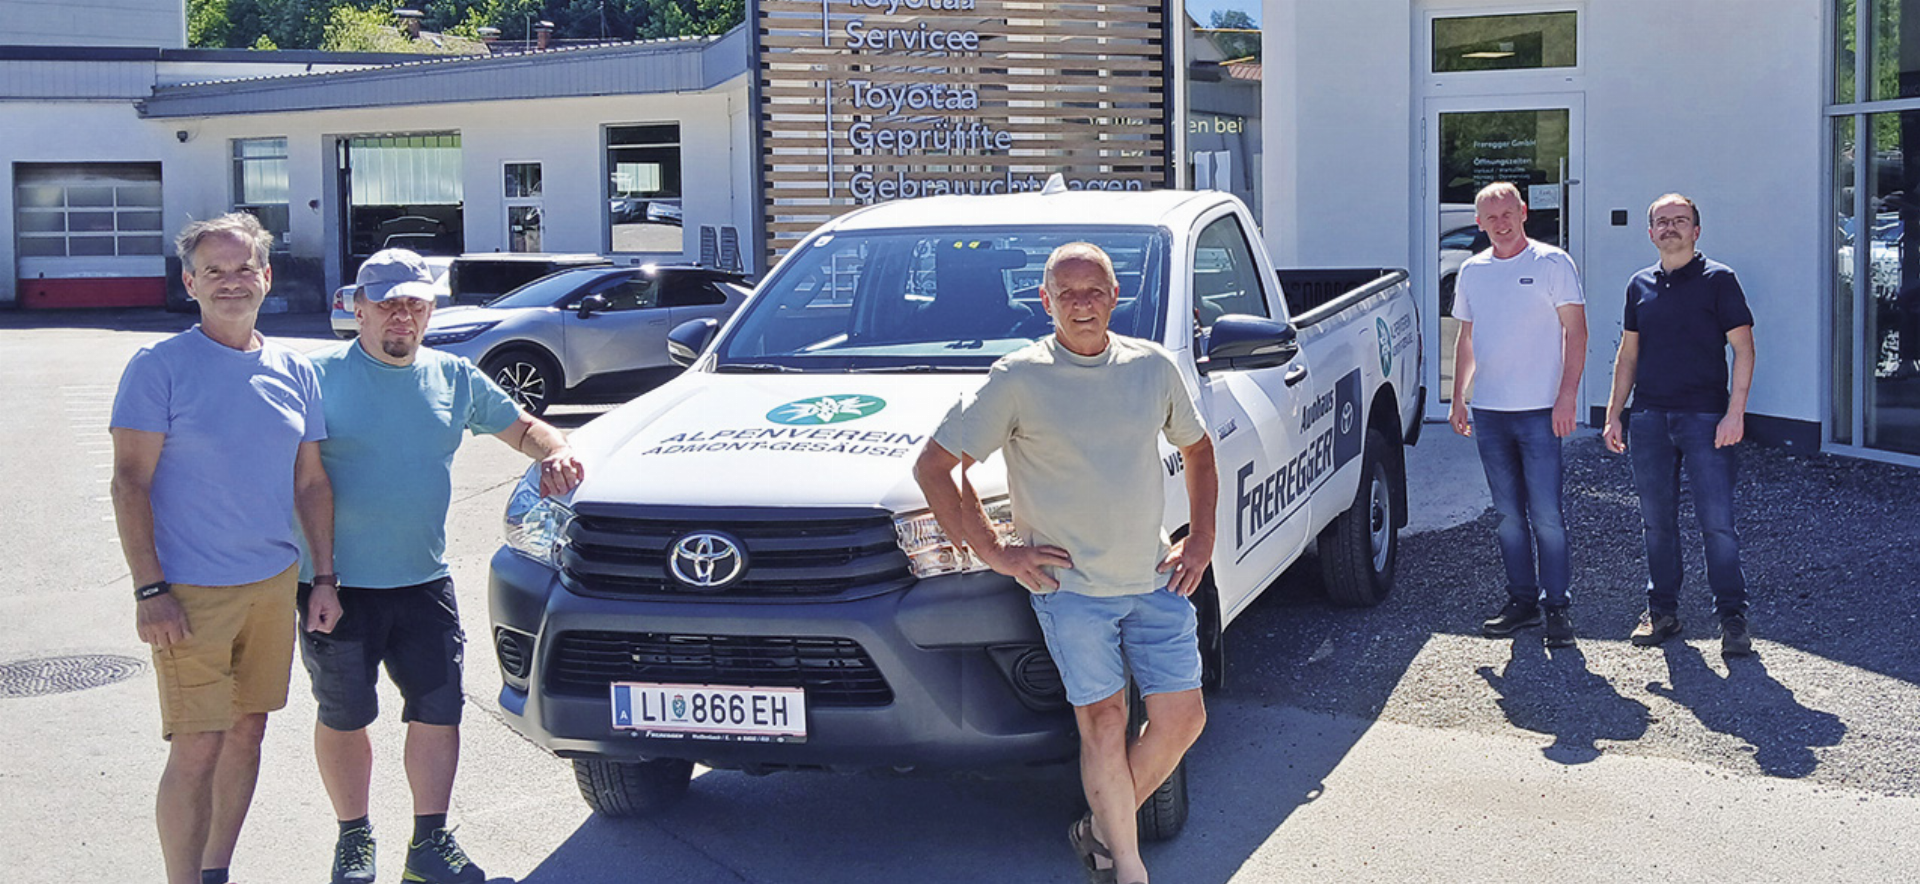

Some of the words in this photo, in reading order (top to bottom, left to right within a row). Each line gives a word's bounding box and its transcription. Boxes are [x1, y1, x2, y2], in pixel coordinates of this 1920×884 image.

[1215, 116, 1243, 133] bei
[660, 428, 924, 445] ALPENVEREIN
[1236, 431, 1333, 551] FREREGGER
[620, 710, 628, 720] A
[642, 692, 666, 721] LI
